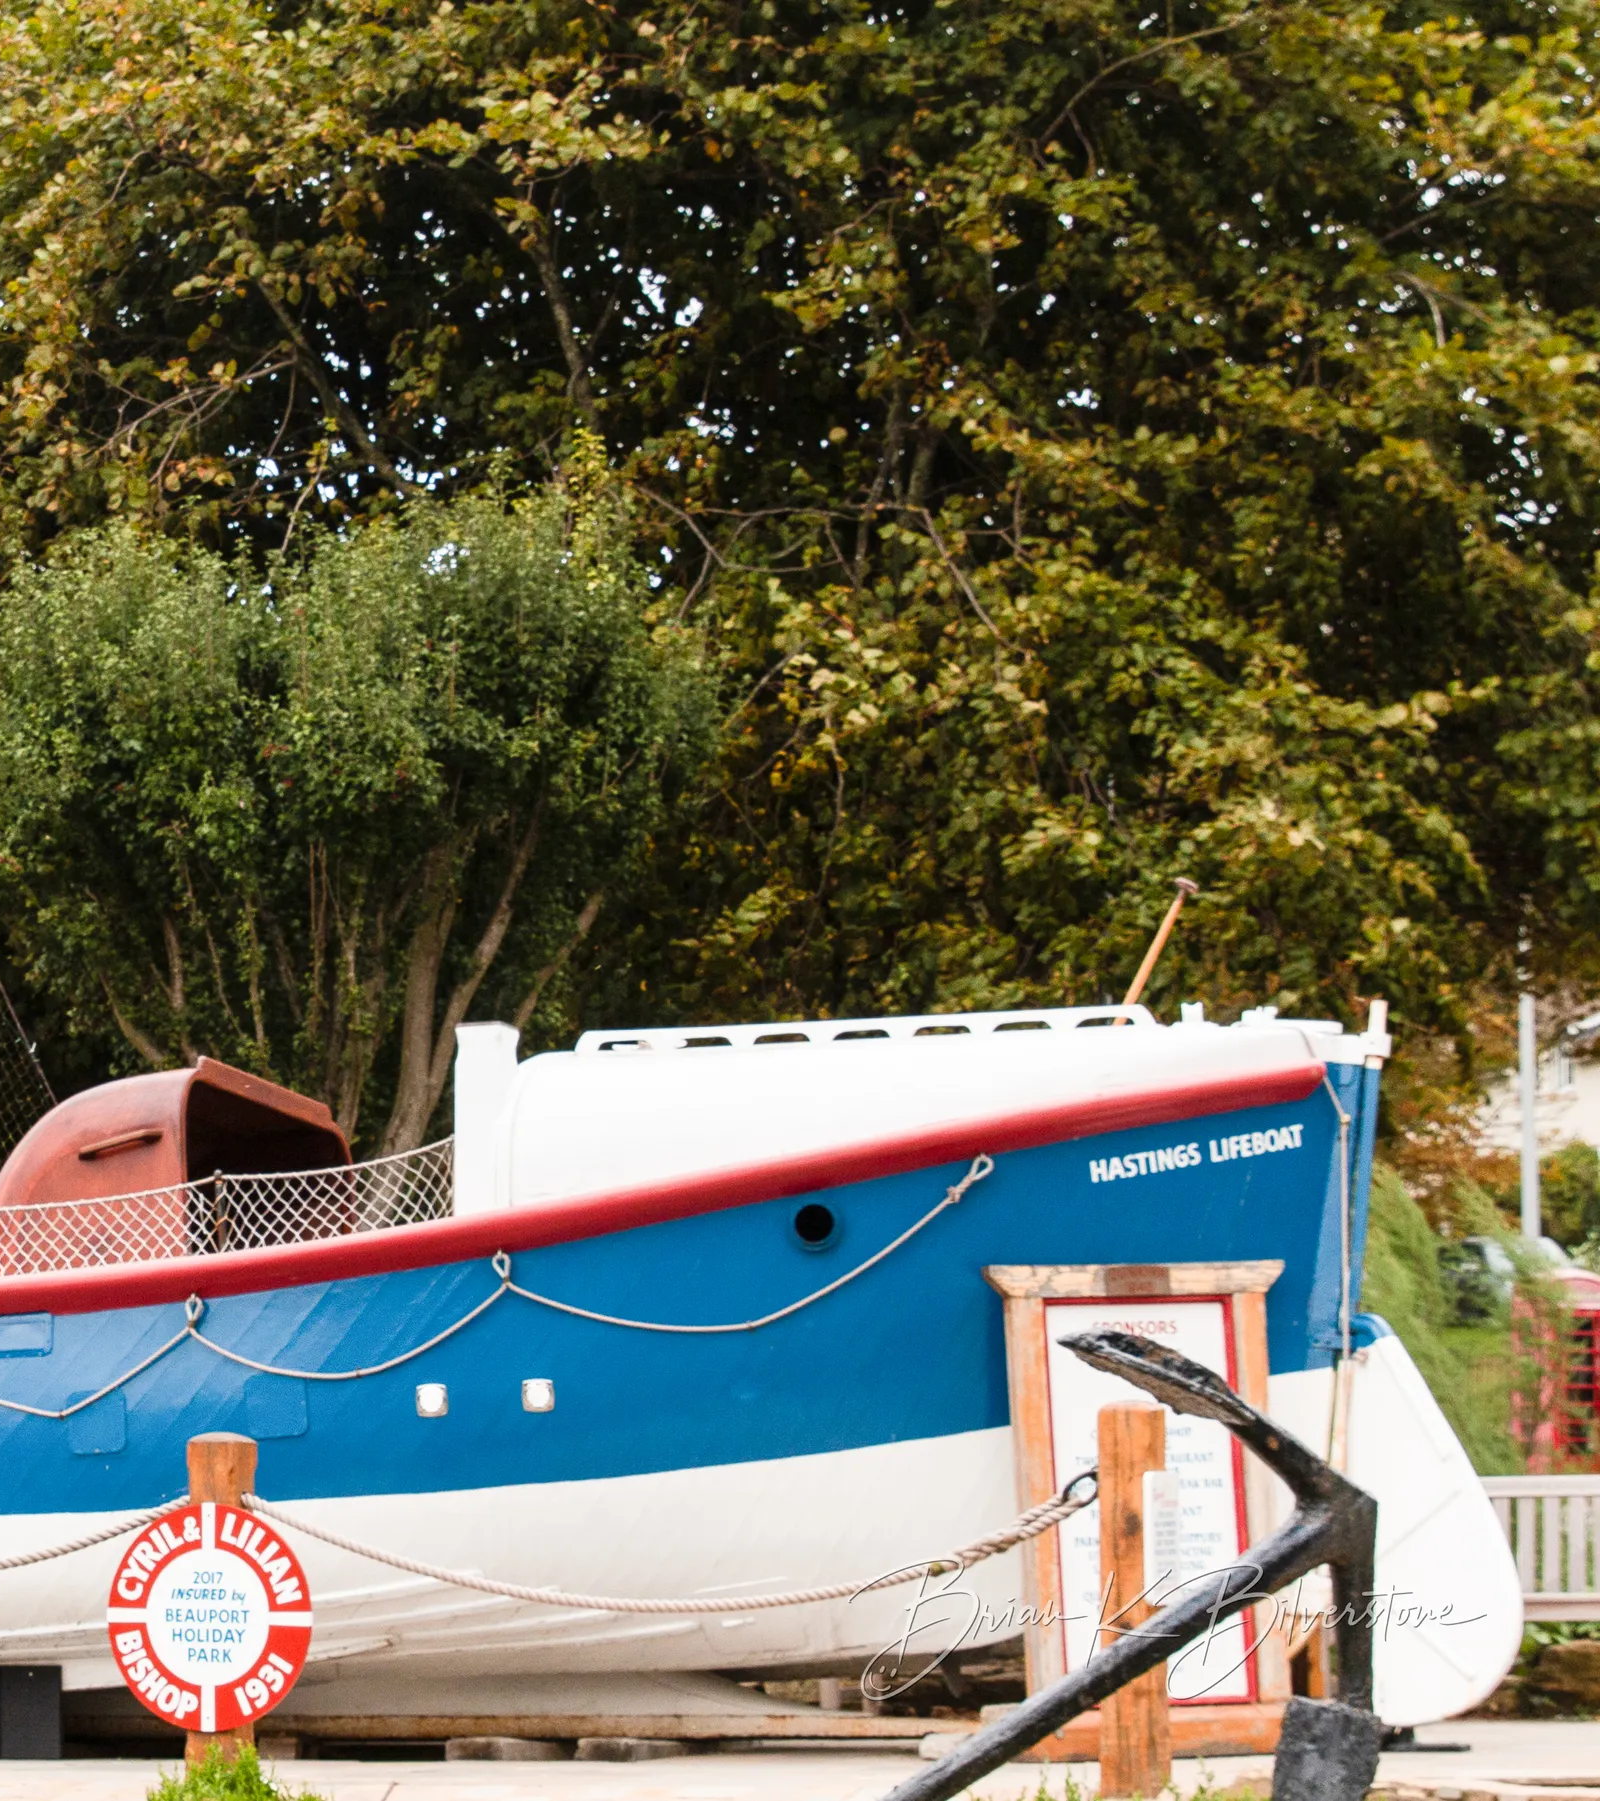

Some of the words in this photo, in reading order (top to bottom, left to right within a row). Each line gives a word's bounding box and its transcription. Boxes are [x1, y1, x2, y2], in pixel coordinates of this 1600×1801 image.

[1089, 1142, 1202, 1183] HASTINGS
[1209, 1123, 1304, 1163] LIFEBOAT
[219, 1511, 304, 1605] LILIAN
[192, 1571, 224, 1585] 2017
[171, 1588, 226, 1601] INSURED
[231, 1589, 247, 1607] by
[165, 1608, 250, 1624] BEAUPORT
[171, 1628, 245, 1644] HOLIDAY
[187, 1647, 232, 1663] PARK
[114, 1629, 200, 1720] BISHOP
[233, 1652, 295, 1717] 1931
